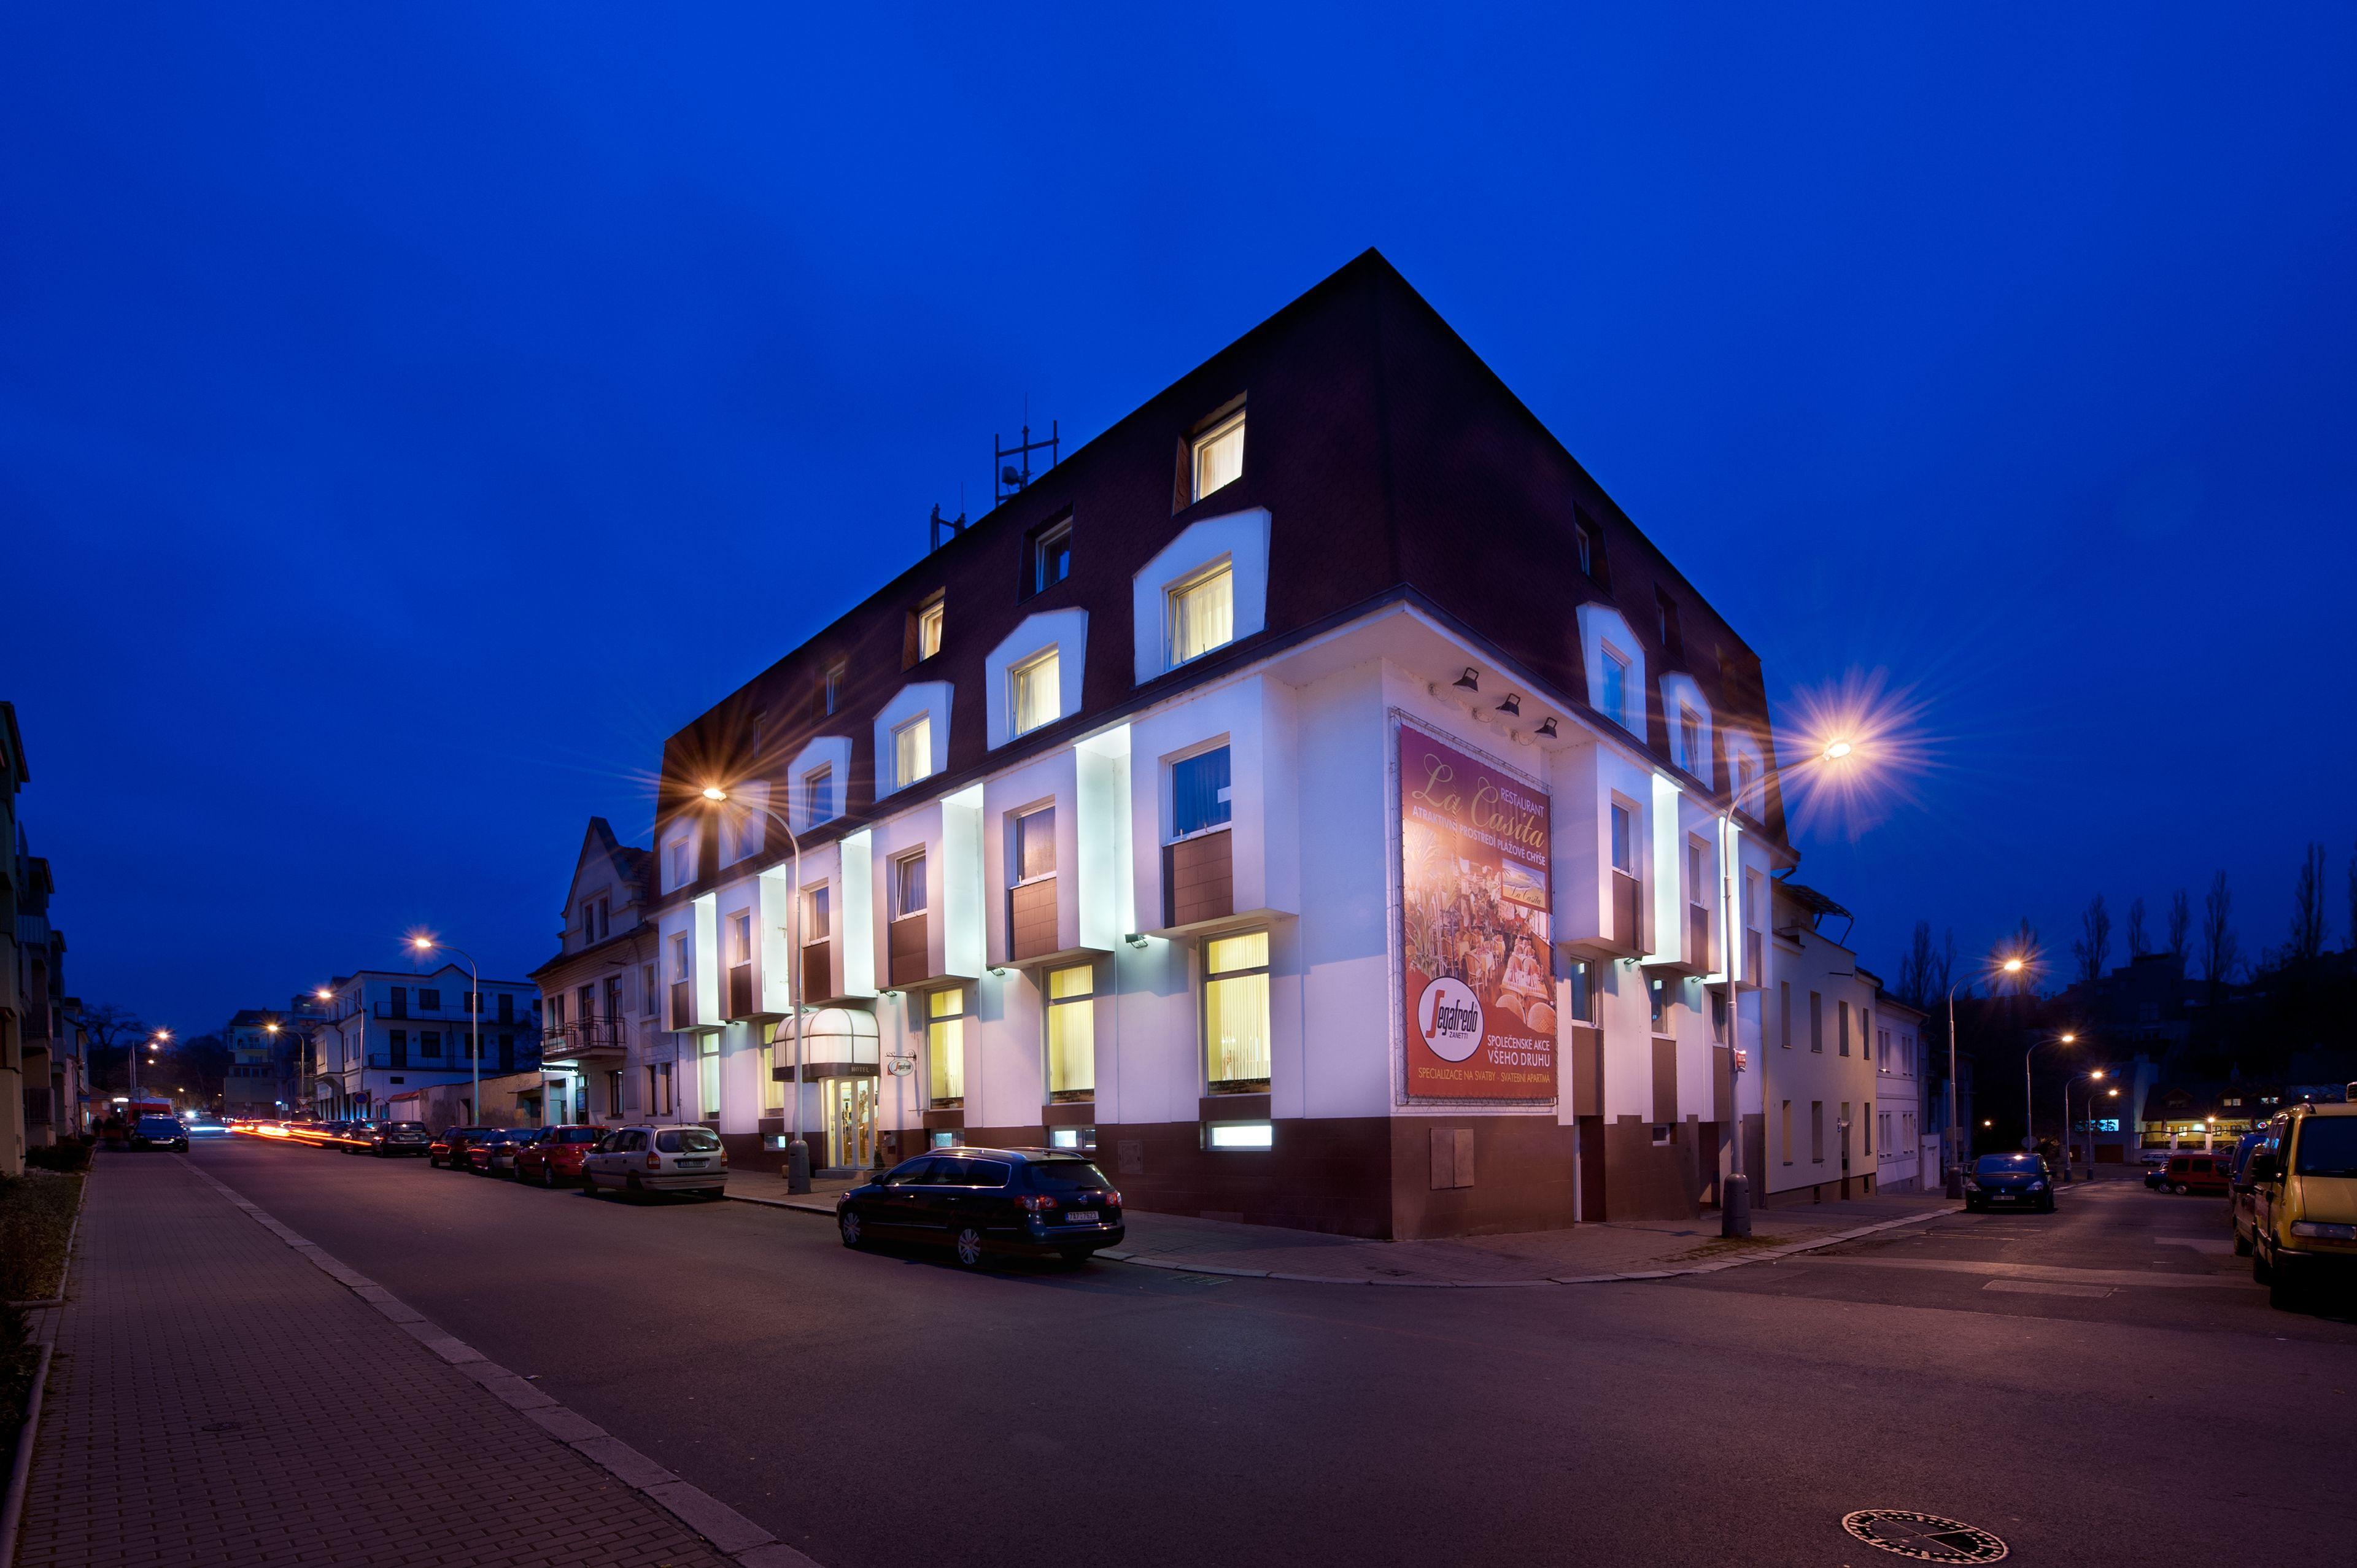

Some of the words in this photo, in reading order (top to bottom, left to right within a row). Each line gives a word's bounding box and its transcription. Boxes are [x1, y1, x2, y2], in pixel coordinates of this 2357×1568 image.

[1412, 754, 1463, 813] La
[1471, 776, 1544, 848] Casita
[1501, 787, 1544, 818] RESTAURANT
[1460, 824, 1496, 847] PROSTŘEDÍ
[1498, 839, 1525, 859] PLÁŽOVÉ
[1527, 851, 1546, 866] CHÝŠE
[1425, 989, 1478, 1038] Segafredo
[1487, 1034, 1533, 1050] SPOLEČENSKÉ
[1534, 1040, 1550, 1051] AKCE
[1487, 1047, 1519, 1065] VŠEHO
[1520, 1052, 1550, 1067] DRUHU
[1418, 1067, 1462, 1080] SPECIALIZACE
[1464, 1070, 1473, 1080] NA
[1474, 1070, 1495, 1081] SVATBY
